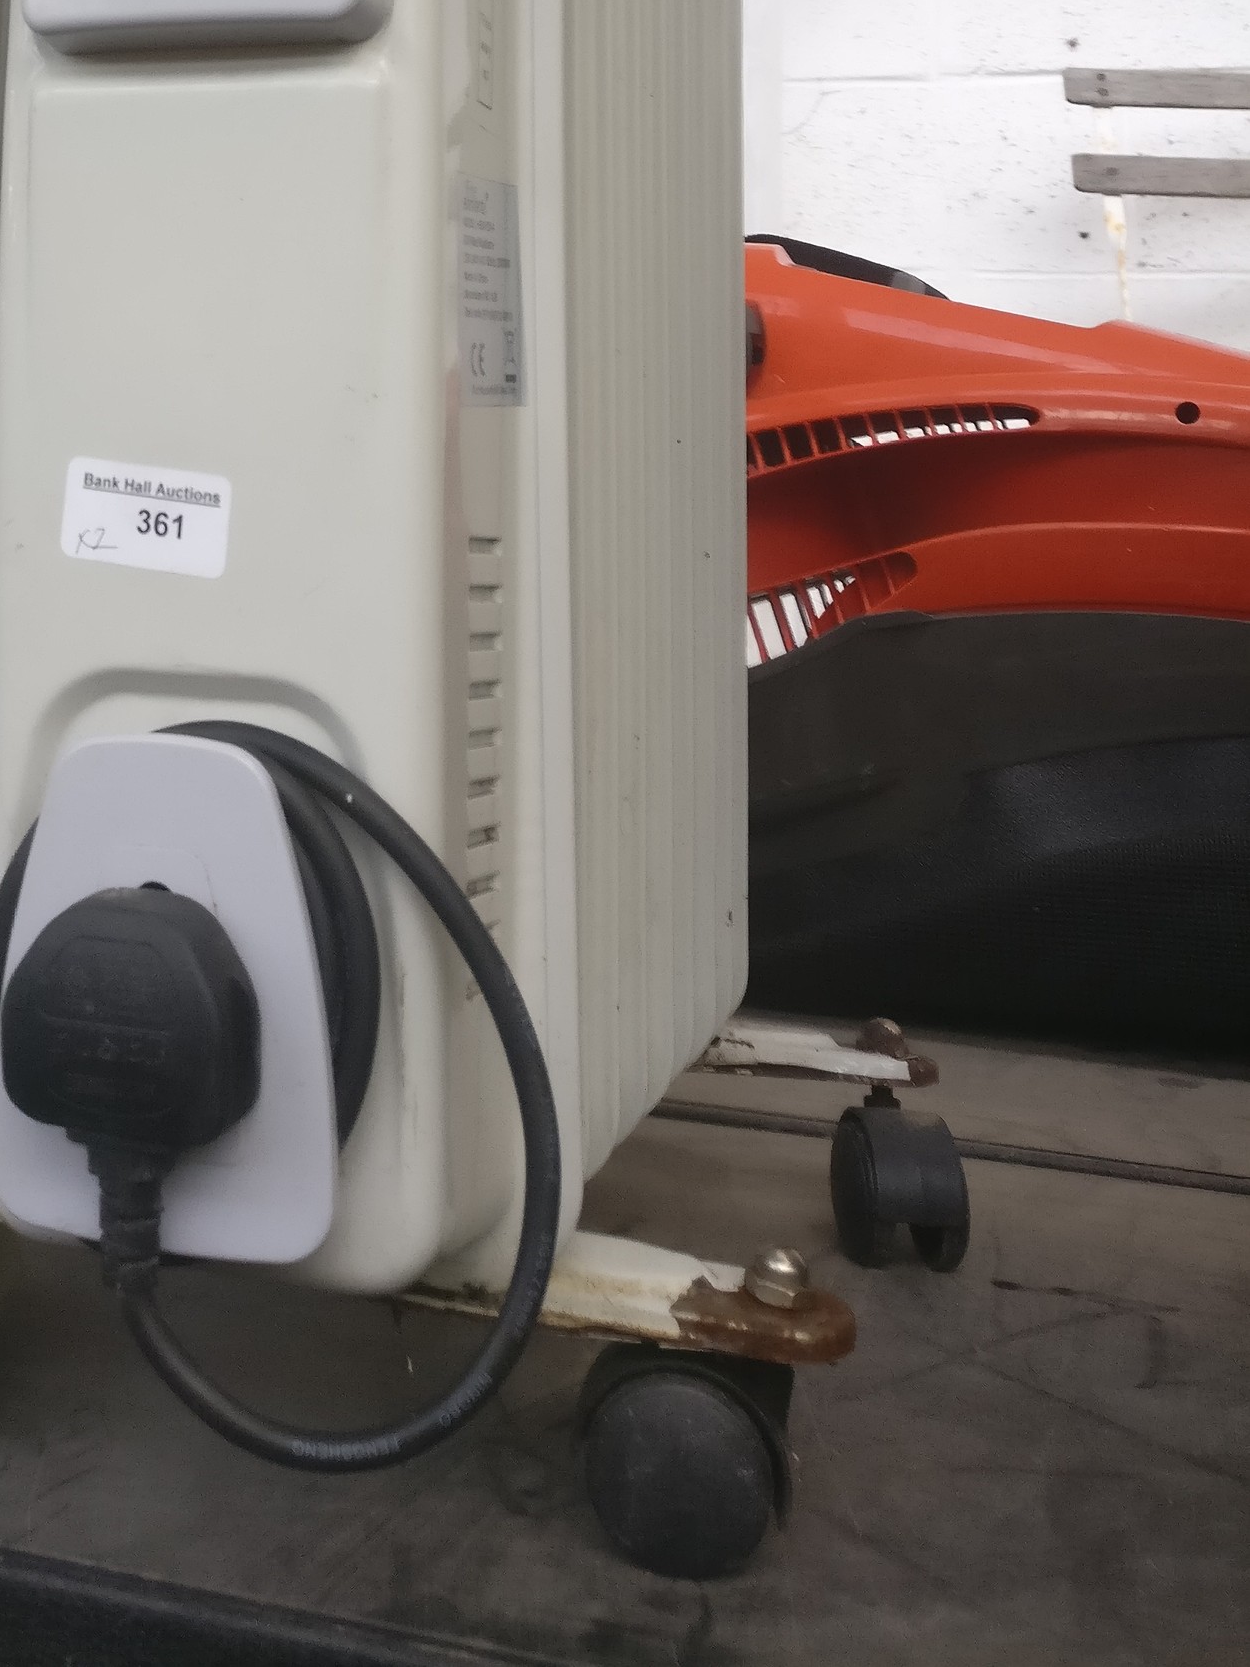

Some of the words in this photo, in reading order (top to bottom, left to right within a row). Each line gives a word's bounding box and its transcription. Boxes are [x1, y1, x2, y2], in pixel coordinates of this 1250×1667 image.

[83, 472, 120, 489] Bank
[124, 478, 152, 494] Hall
[155, 483, 222, 505] Auctions
[136, 509, 184, 539] 361
